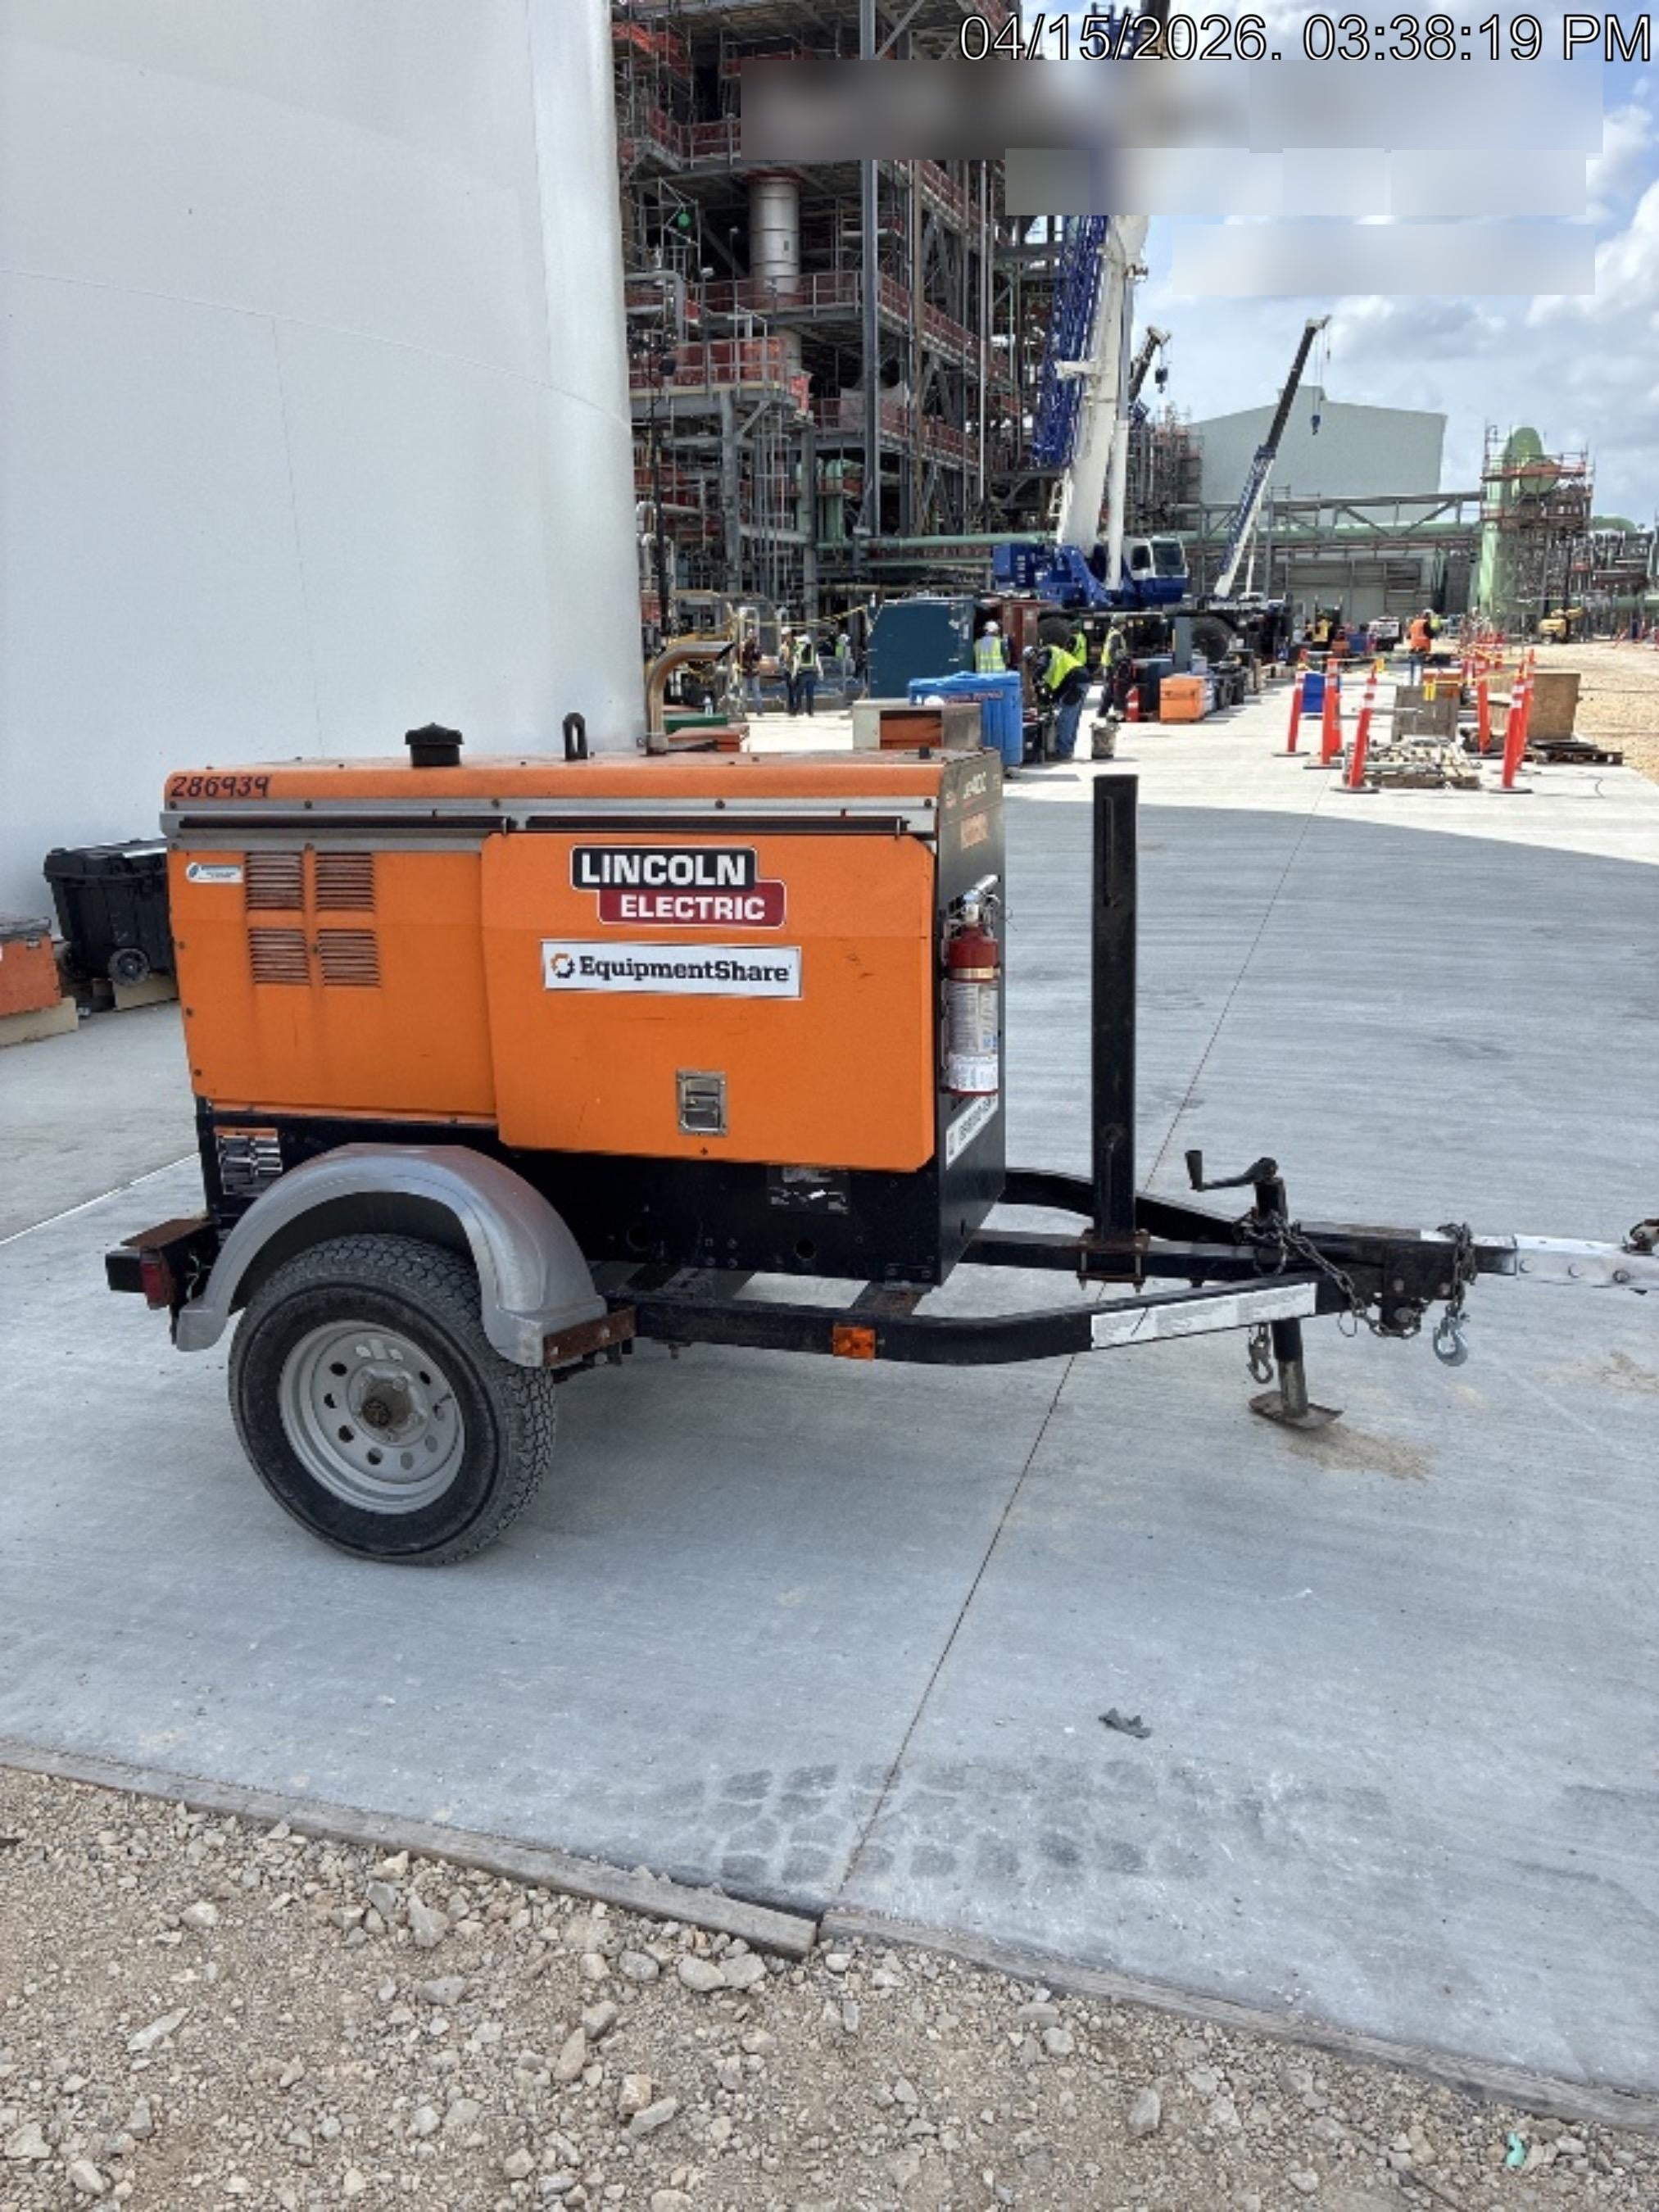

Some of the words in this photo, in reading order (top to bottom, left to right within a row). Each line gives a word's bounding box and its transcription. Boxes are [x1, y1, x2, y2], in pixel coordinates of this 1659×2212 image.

[170, 775, 273, 798] 286939
[580, 853, 746, 886] LINCOLN
[620, 894, 766, 920] ELECTRIC
[578, 954, 791, 982] EquipmentShare
